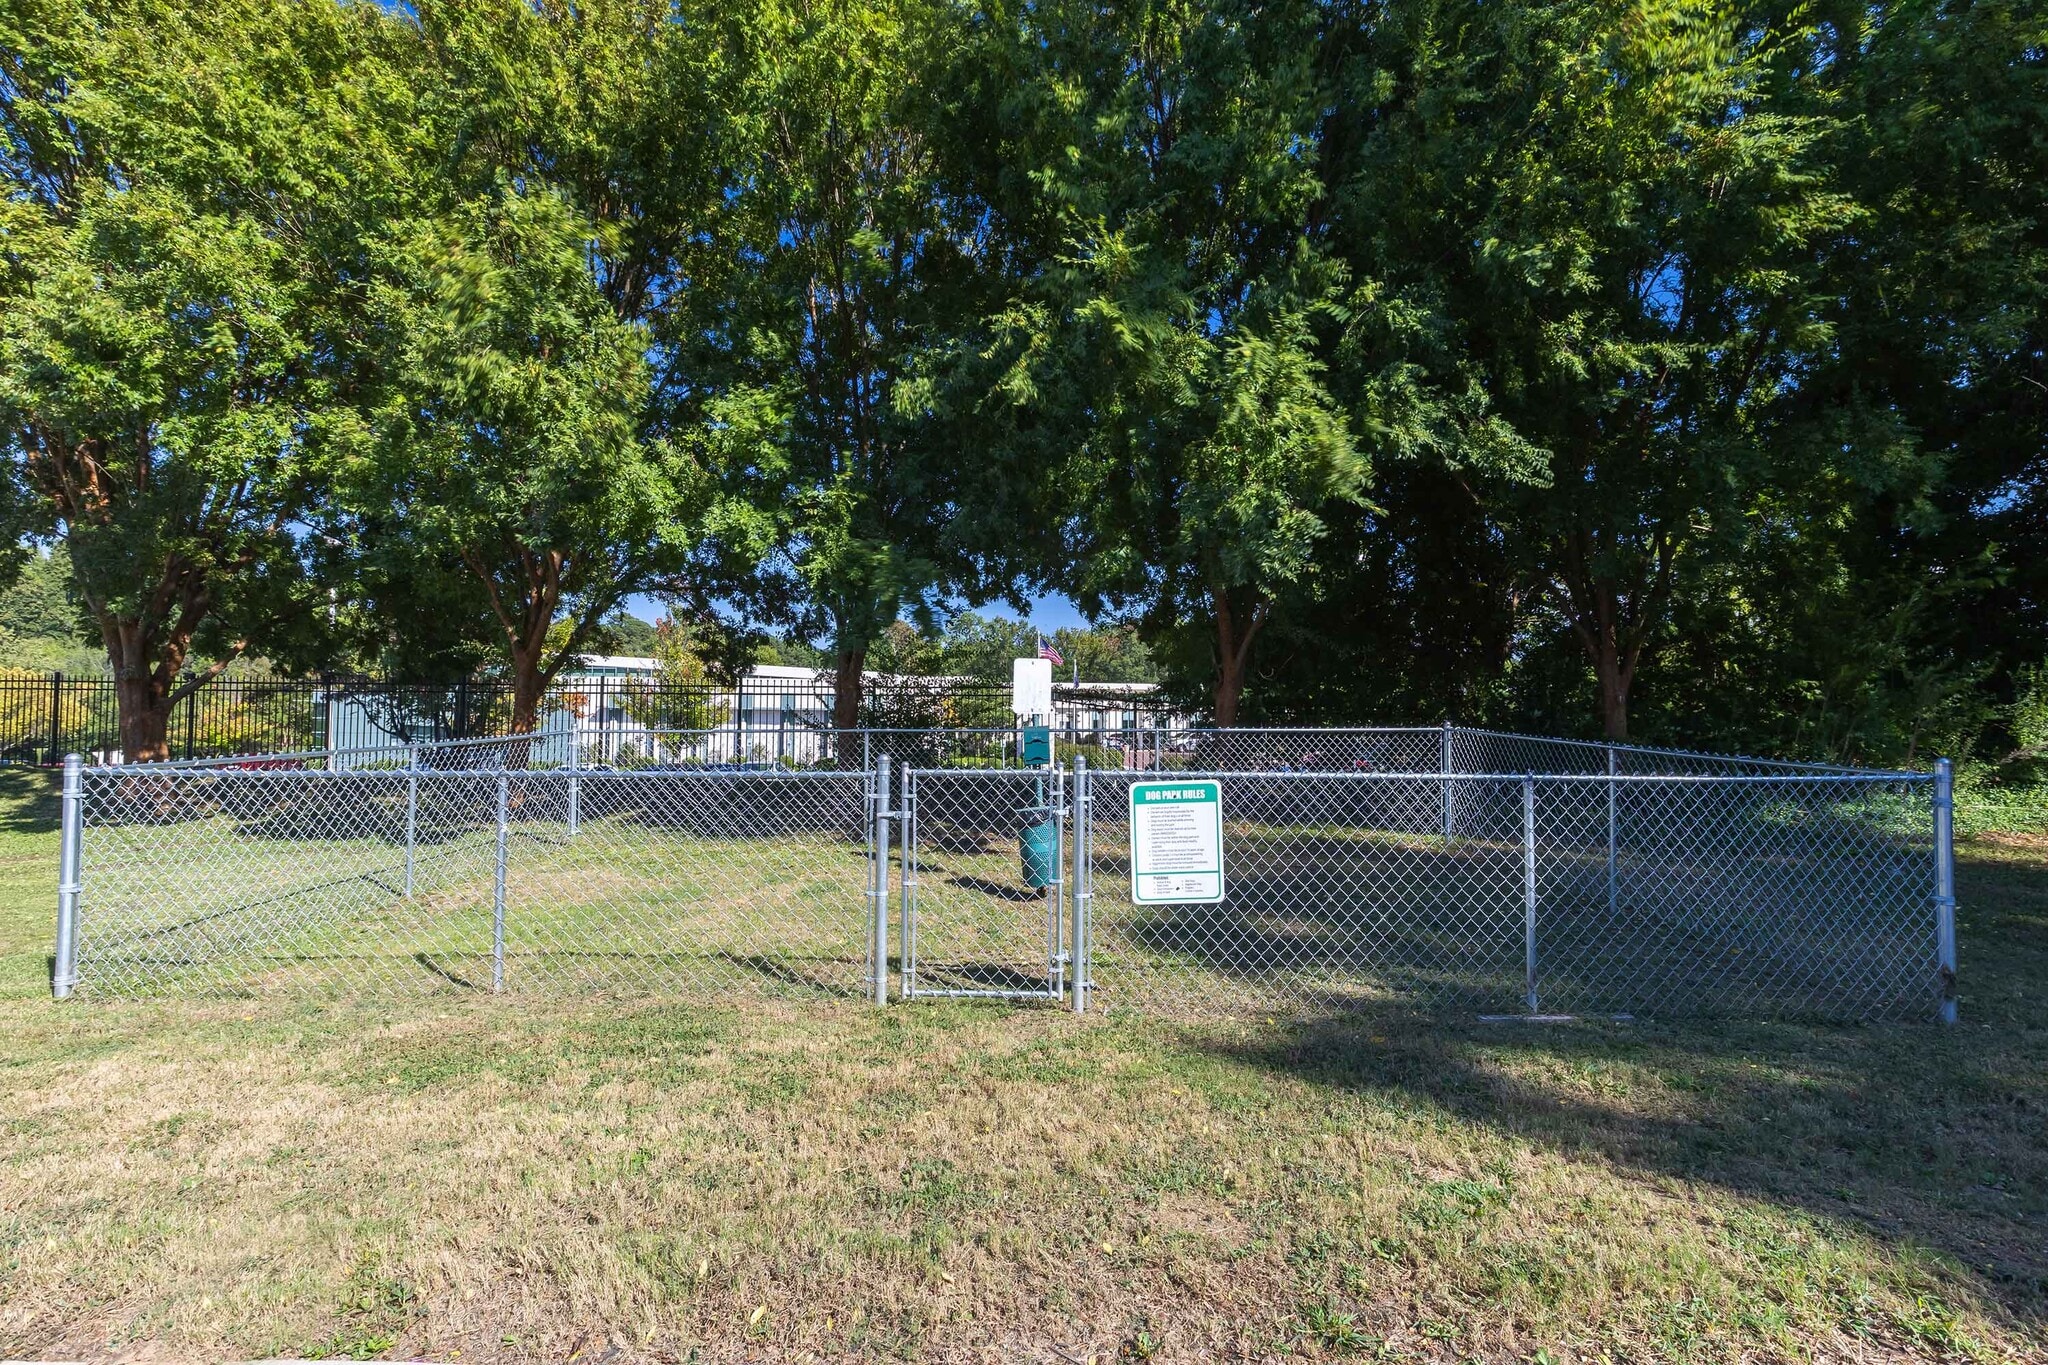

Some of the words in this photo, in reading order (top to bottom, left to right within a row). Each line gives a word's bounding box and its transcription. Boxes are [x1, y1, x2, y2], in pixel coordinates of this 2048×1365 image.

[1145, 791, 1161, 801] DOG
[1162, 790, 1182, 800] PARK
[1183, 789, 1206, 799] RULES
